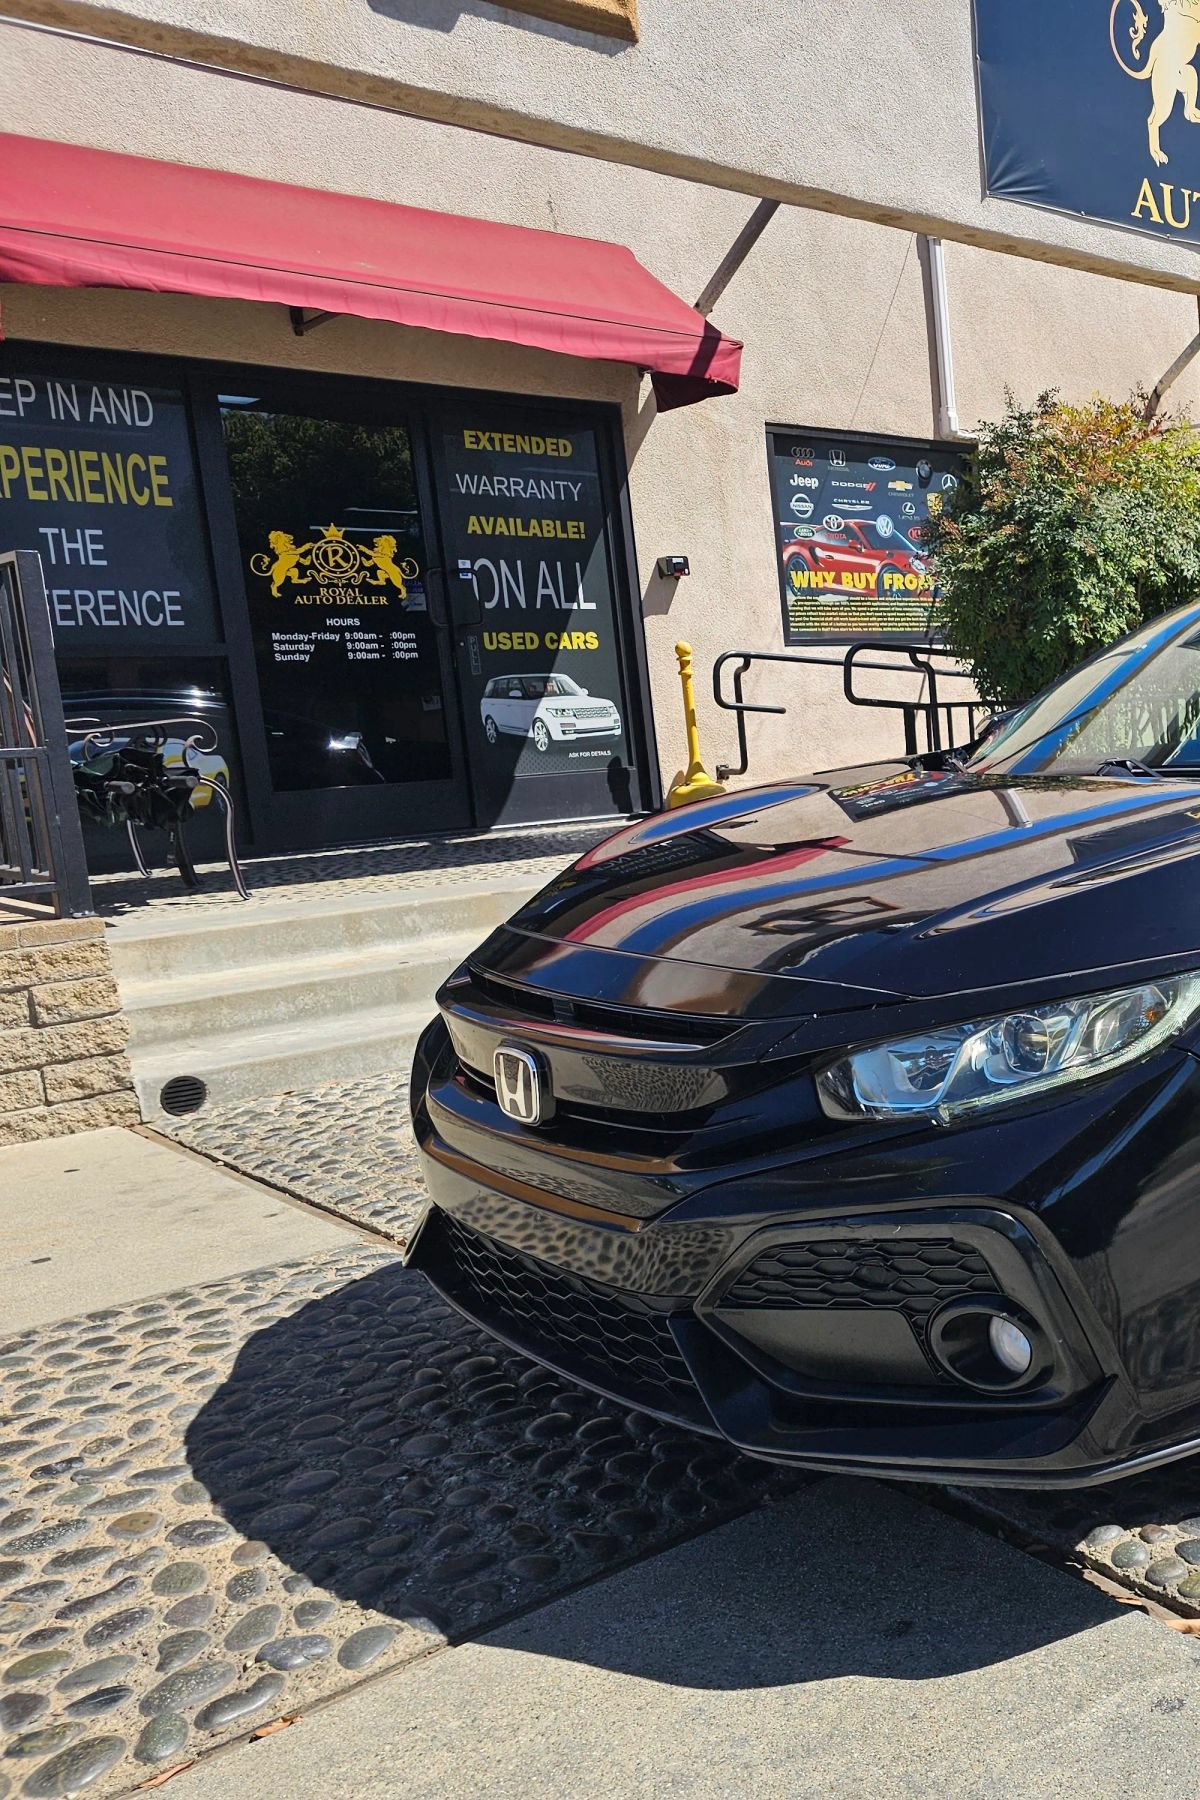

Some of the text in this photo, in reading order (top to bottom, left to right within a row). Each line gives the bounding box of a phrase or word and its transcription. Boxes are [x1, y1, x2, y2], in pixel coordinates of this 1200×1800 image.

[47, 381, 81, 422] IN
[89, 386, 154, 427] AND
[463, 429, 573, 457] EXTENDED
[0, 445, 173, 506] PERIENCE
[790, 473, 819, 490] Jeep
[455, 473, 582, 501] WARRANTY
[467, 515, 586, 539] AVAILABLE!
[38, 527, 108, 566] THE
[472, 557, 597, 610] ON ALL
[790, 570, 835, 589] WHY
[841, 571, 878, 590] BUY
[294, 595, 389, 606] AUTO DEALER
[319, 587, 363, 597] ROYAL
[46, 589, 185, 627] ERENCE
[326, 618, 361, 626] HOURS
[271, 632, 340, 642] Monday-Friday
[344, 631, 377, 640] 9:00am
[273, 642, 316, 652] Saturday
[346, 641, 379, 650] 9:00am
[483, 631, 600, 651] USED CARS
[274, 652, 311, 662] Sunday
[347, 651, 380, 660] 9:00am
